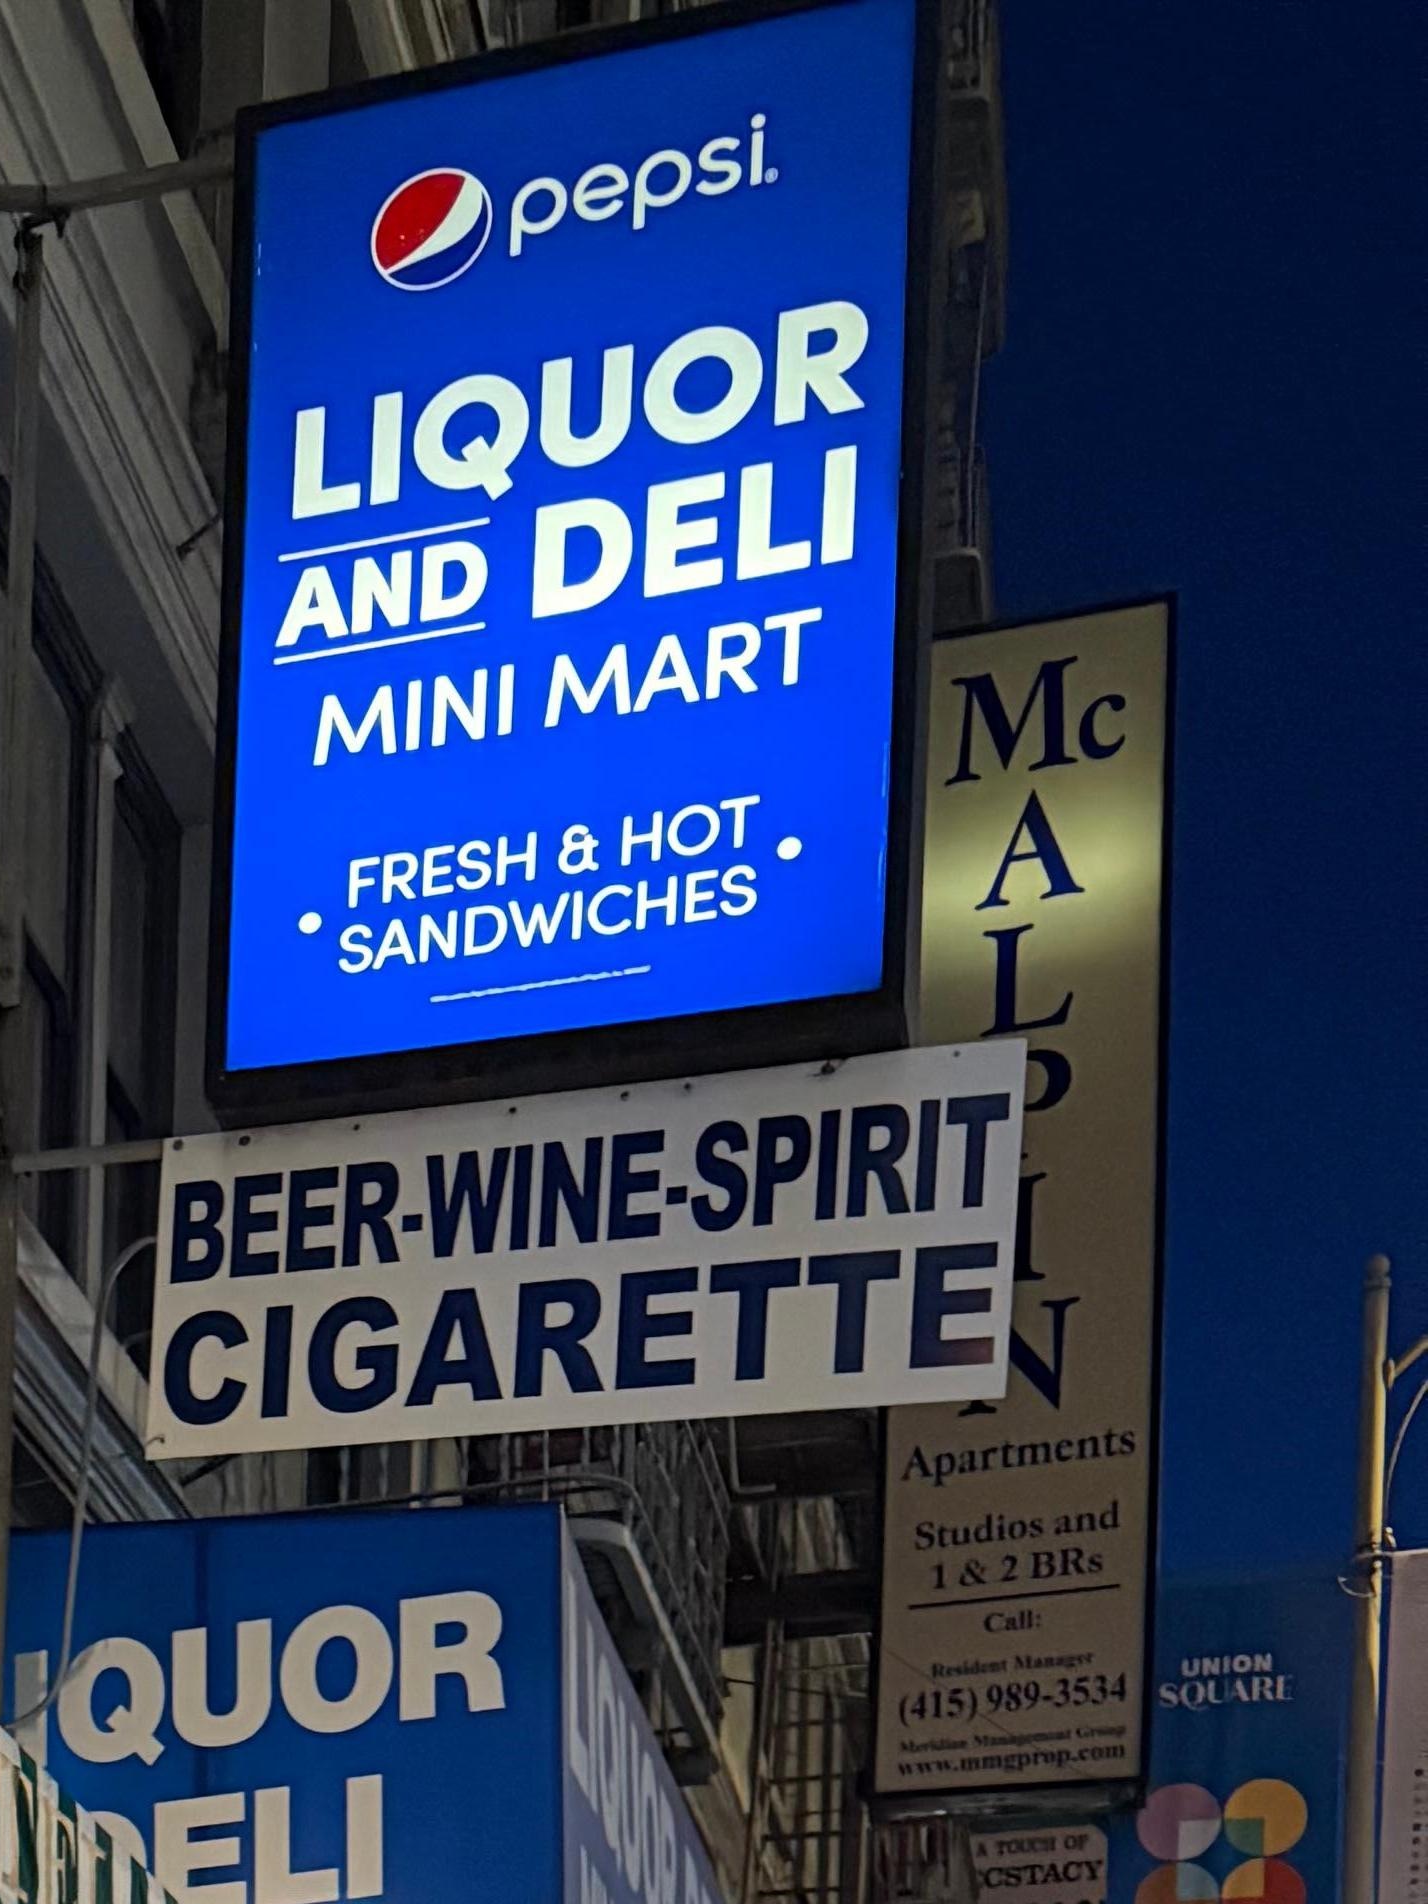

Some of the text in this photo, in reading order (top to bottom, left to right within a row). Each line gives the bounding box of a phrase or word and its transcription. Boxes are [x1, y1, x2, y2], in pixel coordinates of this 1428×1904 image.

[510, 112, 770, 256] pepsi
[292, 299, 868, 519] LIQUOR
[276, 445, 857, 648] AND DELI
[312, 607, 823, 767] MINI MART
[346, 795, 761, 908] FRESH & HOT
[337, 866, 758, 975] SANDWICHES
[169, 1092, 1011, 1285] BEER-WINE-SPIRIT
[162, 1241, 999, 1427] CIGARETTE
[901, 1428, 1136, 1487] Apartments
[914, 1499, 1120, 1551] Studios and
[932, 1547, 1103, 1589] 1 & 2 BRs
[983, 1610, 1042, 1633] Call:
[14, 1590, 505, 1768] IQUOR
[898, 1672, 1126, 1728] (415) 989-3534
[931, 1651, 1095, 1679] Resident Manager
[1158, 1673, 1294, 1711] SQUARE
[1180, 1652, 1274, 1677] UNION
[978, 1860, 1104, 1889] CSTACY
